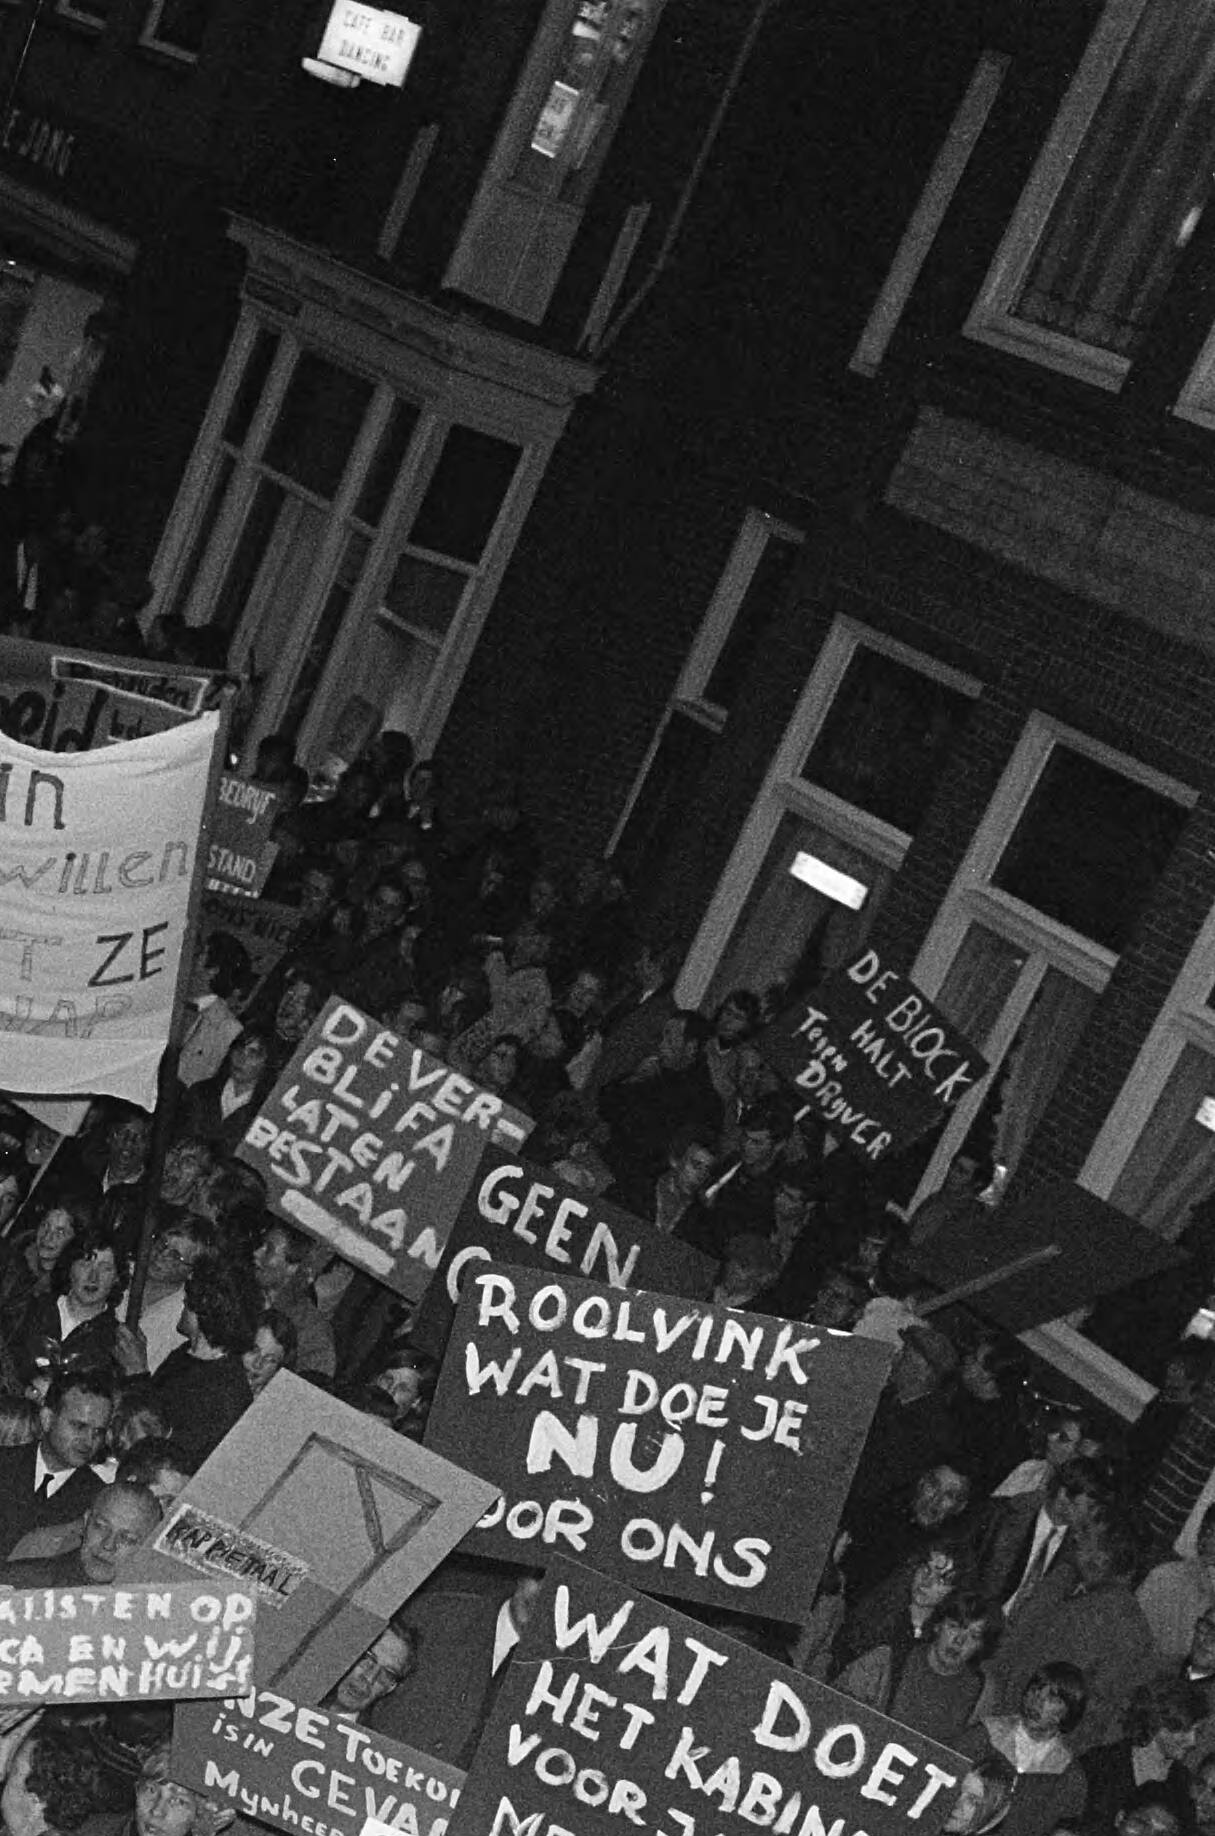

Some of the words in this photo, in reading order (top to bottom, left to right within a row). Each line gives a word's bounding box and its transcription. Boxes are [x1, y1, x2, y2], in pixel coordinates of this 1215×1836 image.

[86, 920, 169, 989] ZE
[847, 949, 899, 1005] DE
[322, 1003, 401, 1069] DE
[850, 1018, 913, 1088] HALT
[280, 1085, 417, 1193] LATEN
[244, 1117, 447, 1269] BESTAAN
[477, 1163, 641, 1289] GEEN
[473, 1272, 821, 1385] ROOLVINK
[464, 1340, 607, 1404] WAT
[617, 1369, 730, 1431] DOE
[739, 1393, 810, 1454] JE
[620, 1517, 774, 1588] ONS
[68, 1634, 127, 1662] EN
[523, 1659, 656, 1751] HET
[550, 1584, 730, 1705] WAT
[751, 1679, 957, 1820] DOET
[506, 1721, 649, 1827] VOOR
